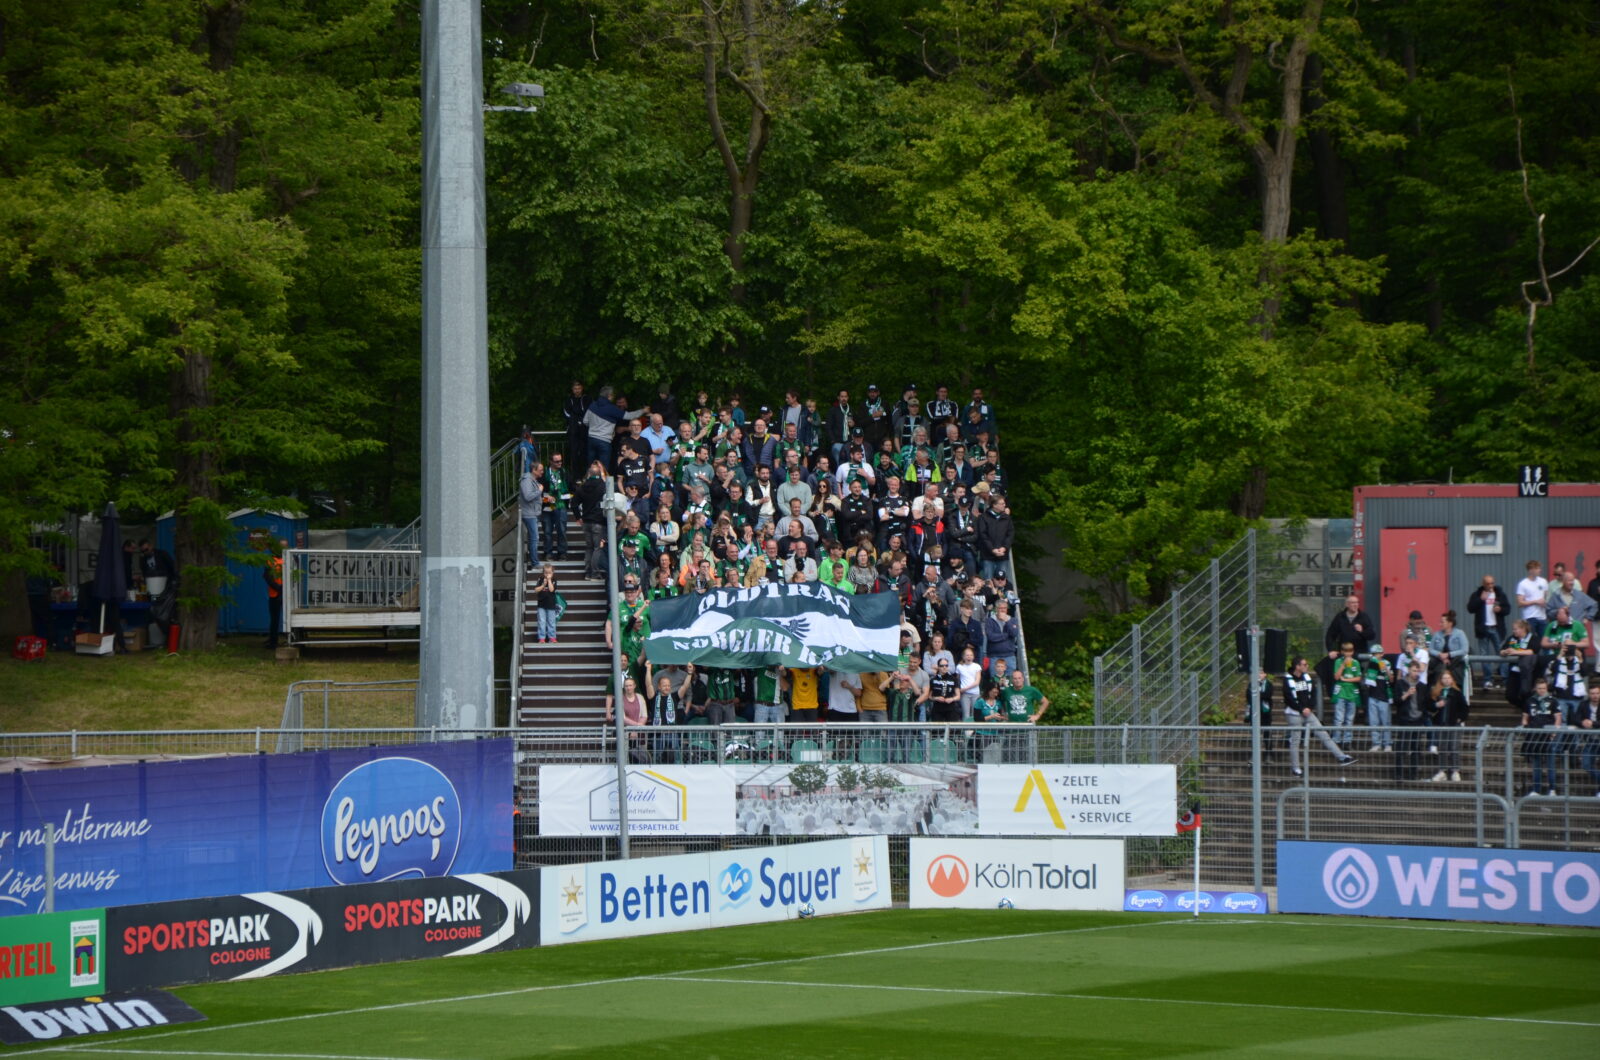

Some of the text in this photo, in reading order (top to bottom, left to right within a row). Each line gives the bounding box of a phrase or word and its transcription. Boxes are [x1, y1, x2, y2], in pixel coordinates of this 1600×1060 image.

[1521, 482, 1546, 496] WC
[1062, 776, 1098, 786] ZELTE
[1071, 794, 1121, 804] HALLEN
[17, 802, 152, 849] mditerrane
[1079, 812, 1132, 823] SERVICE
[590, 823, 680, 831] WWW.ZTE-SPAETH.DE
[600, 857, 841, 924] Betten Sauer
[1386, 855, 1600, 914] WESTO
[343, 894, 482, 933] SPORTSPARK
[123, 913, 271, 955] SPORTSPARK
[424, 926, 482, 942] COLOGNE
[210, 947, 271, 965] COLOGNE
[0, 996, 169, 1039] bwin
